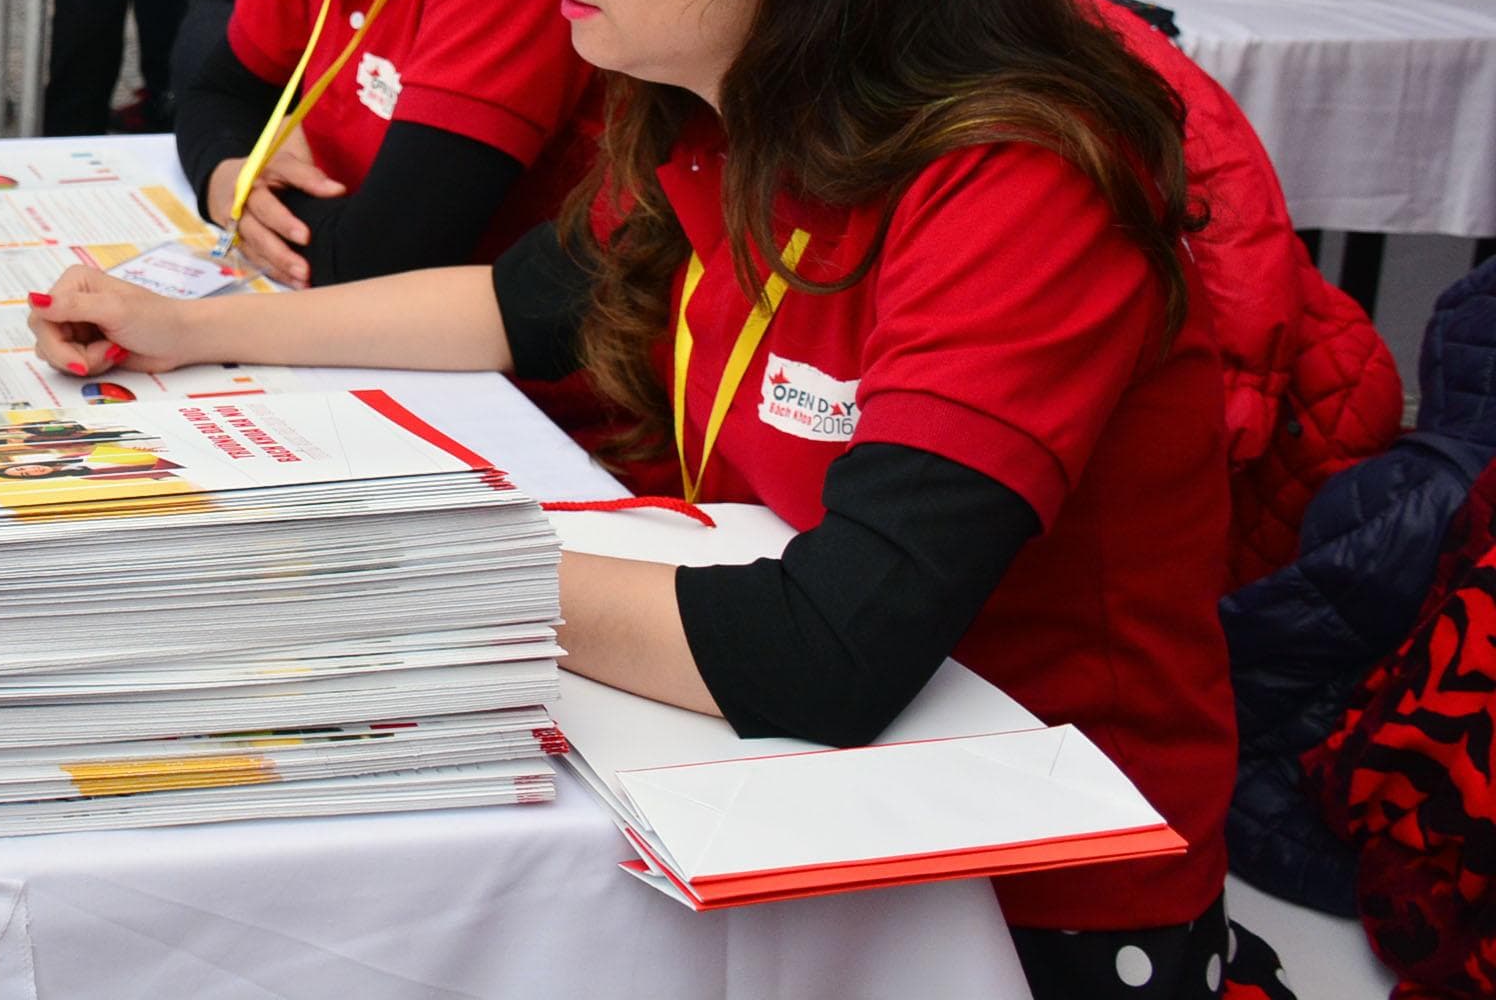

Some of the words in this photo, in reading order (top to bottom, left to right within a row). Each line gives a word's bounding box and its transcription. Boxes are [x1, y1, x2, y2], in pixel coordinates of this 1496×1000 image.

[773, 385, 815, 411] OPEN
[812, 414, 854, 436] 2016
[239, 428, 278, 445] KHOA
